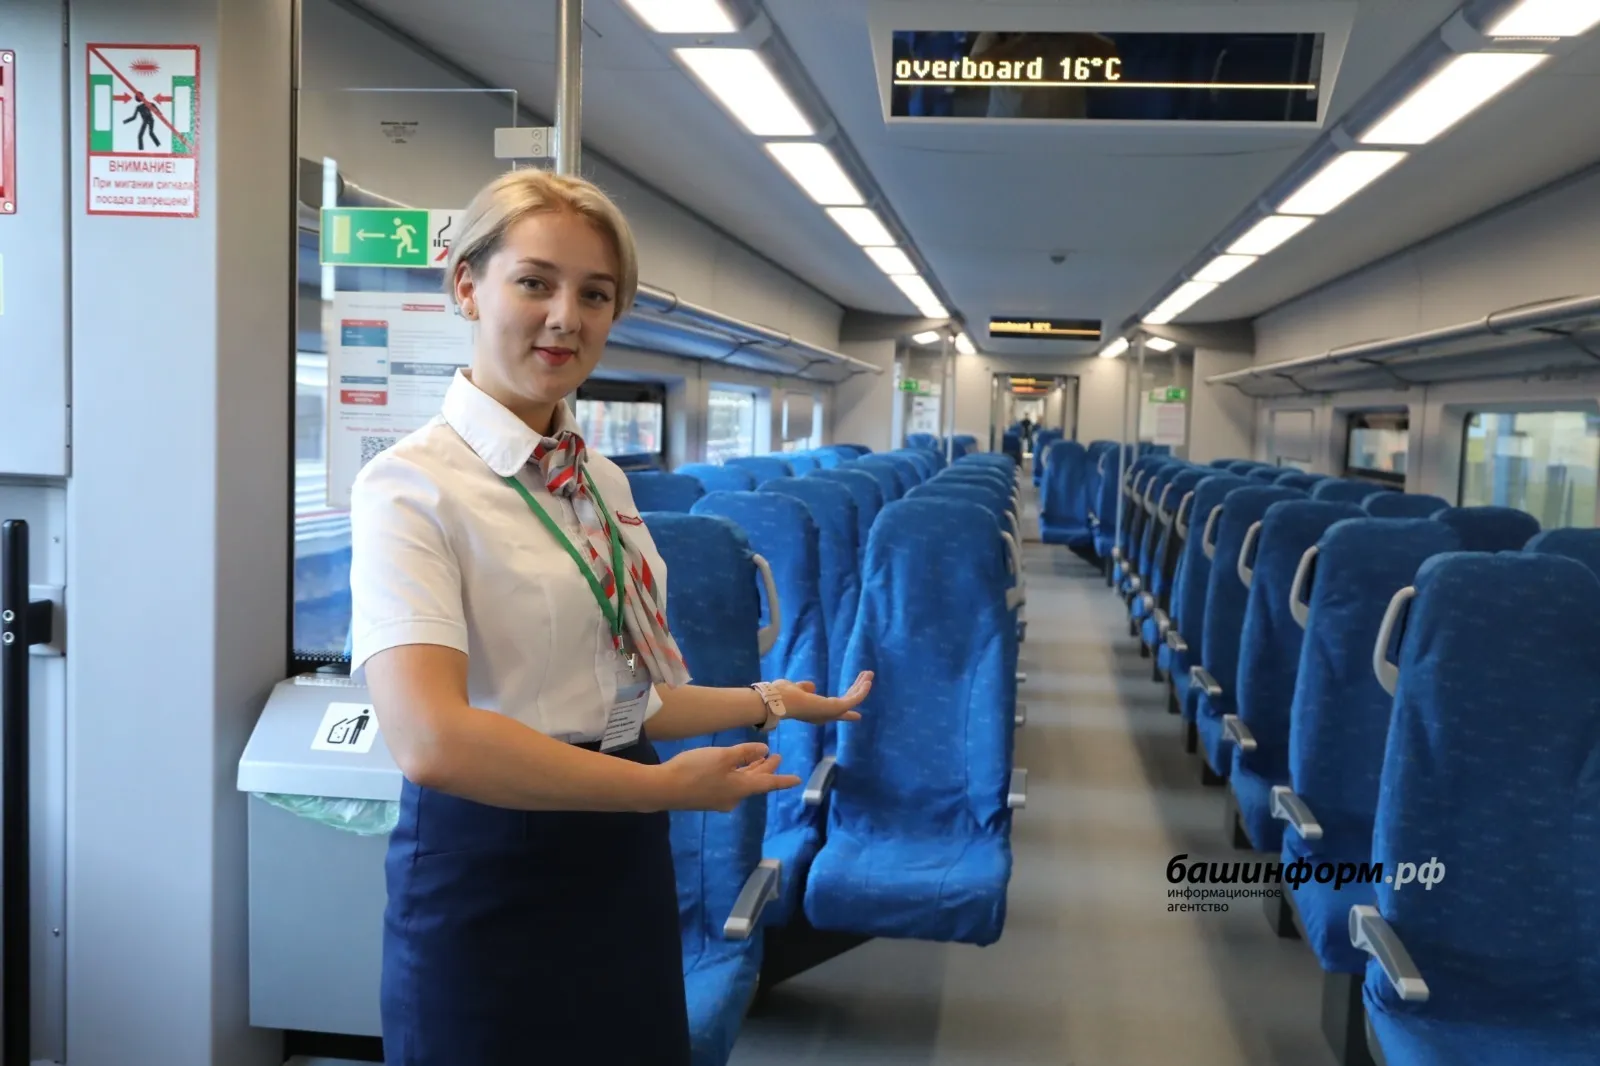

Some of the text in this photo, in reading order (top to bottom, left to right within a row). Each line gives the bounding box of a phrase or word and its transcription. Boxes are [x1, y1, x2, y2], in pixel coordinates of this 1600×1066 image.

[896, 57, 1121, 81] overboard 16°C
[109, 160, 176, 173] ВНИМАНИЕ!
[93, 176, 111, 190] При
[115, 180, 154, 190] мигании
[96, 195, 134, 205] посадка
